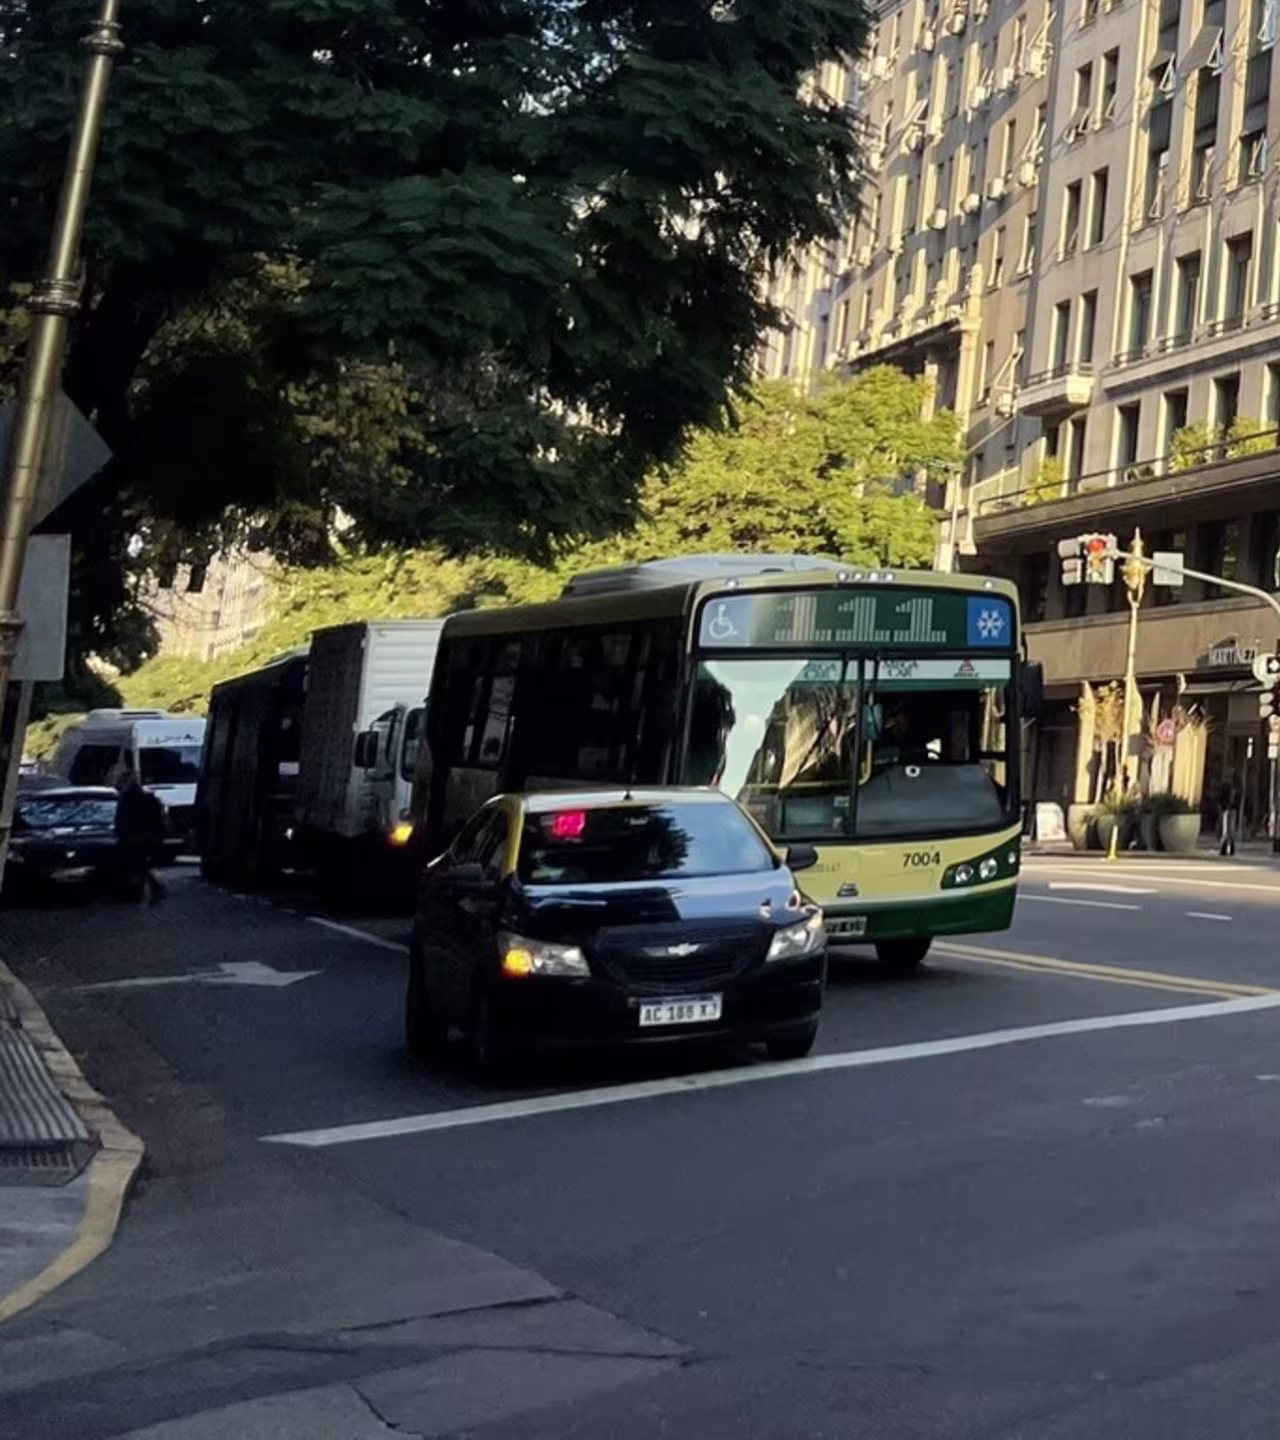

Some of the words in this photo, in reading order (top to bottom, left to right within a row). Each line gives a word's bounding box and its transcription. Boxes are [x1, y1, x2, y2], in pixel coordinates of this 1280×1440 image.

[774, 596, 946, 643] 111
[903, 851, 941, 868] 7004
[644, 1007, 662, 1023] AC
